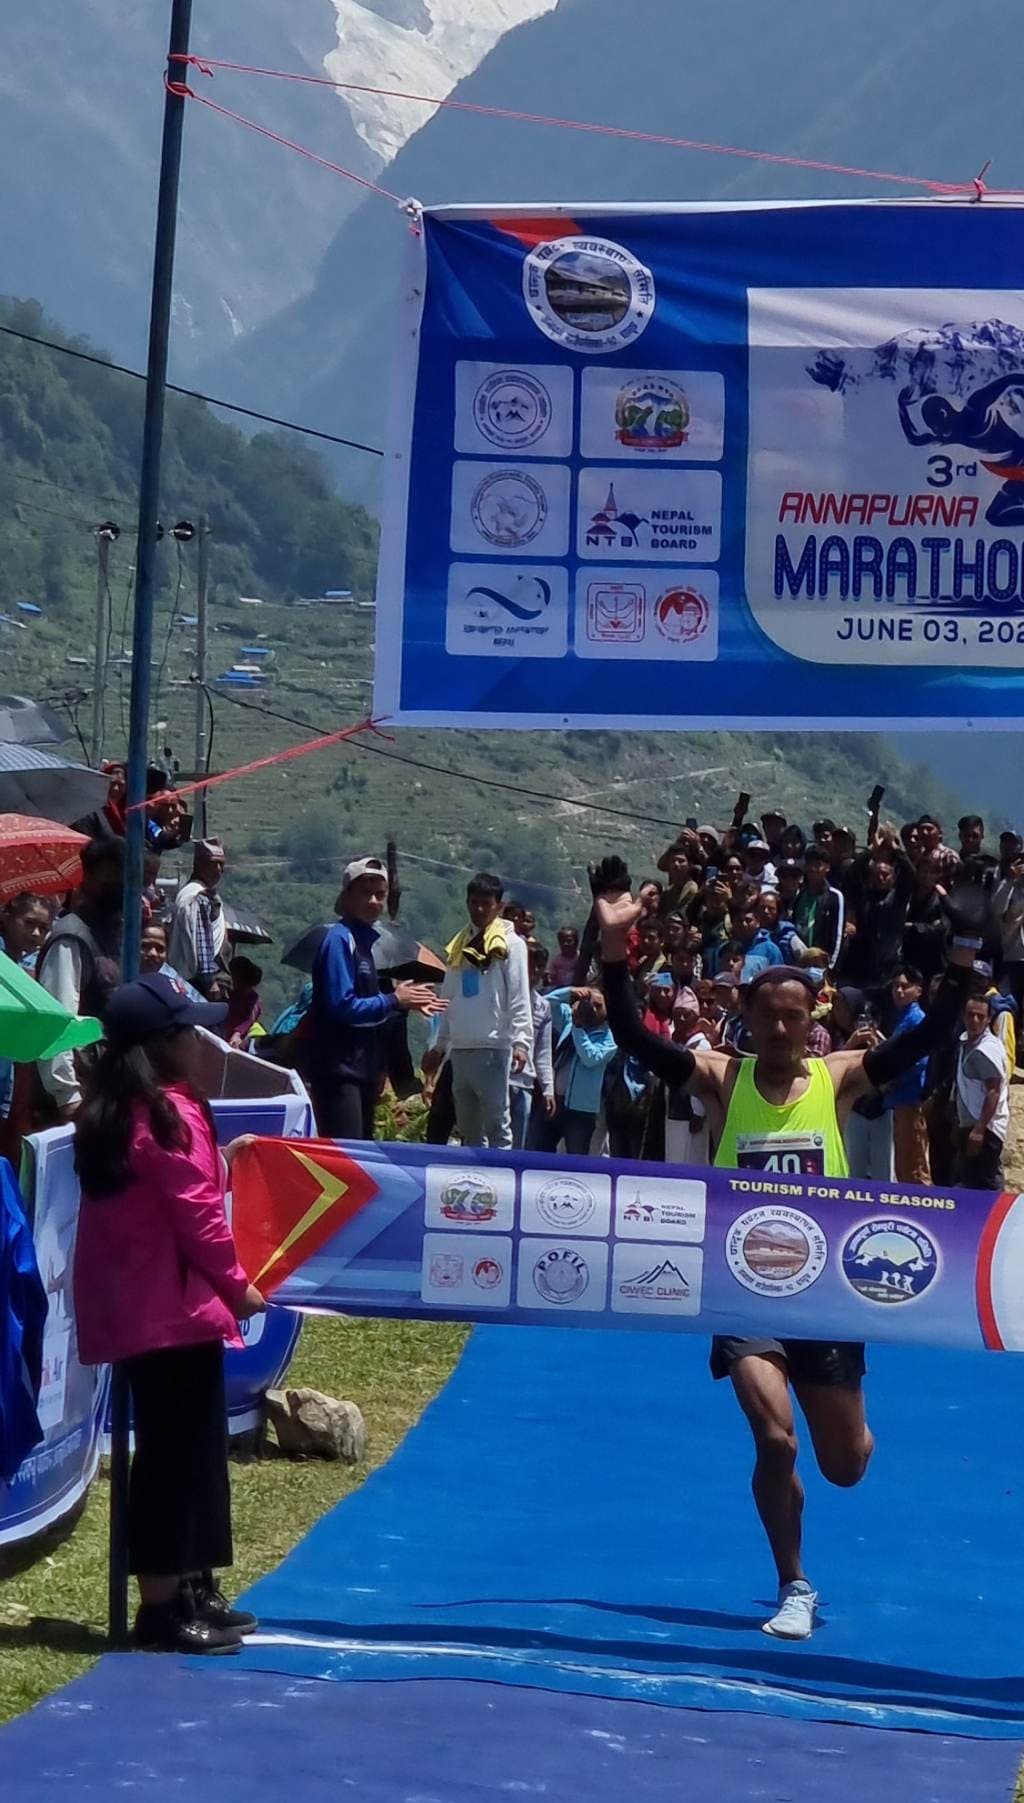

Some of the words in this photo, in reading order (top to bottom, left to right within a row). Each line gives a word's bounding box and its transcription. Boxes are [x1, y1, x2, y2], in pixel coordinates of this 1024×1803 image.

[926, 455, 978, 488] 3rd
[652, 511, 694, 521] NEPAL
[779, 492, 980, 528] ANNAPURNA
[652, 524, 713, 536] TOURISM
[652, 539, 698, 549] BOARD
[837, 618, 913, 641] JUNE
[923, 620, 967, 645] 03,
[763, 1153, 801, 1175] 40
[729, 1179, 803, 1196] TOURISM
[807, 1186, 840, 1199] FOR
[844, 1190, 875, 1202] ALL
[879, 1193, 956, 1210] SEASONS
[537, 1250, 588, 1274] POFIL
[619, 1285, 654, 1297] CIWEC
[656, 1288, 690, 1298] CLINIC
